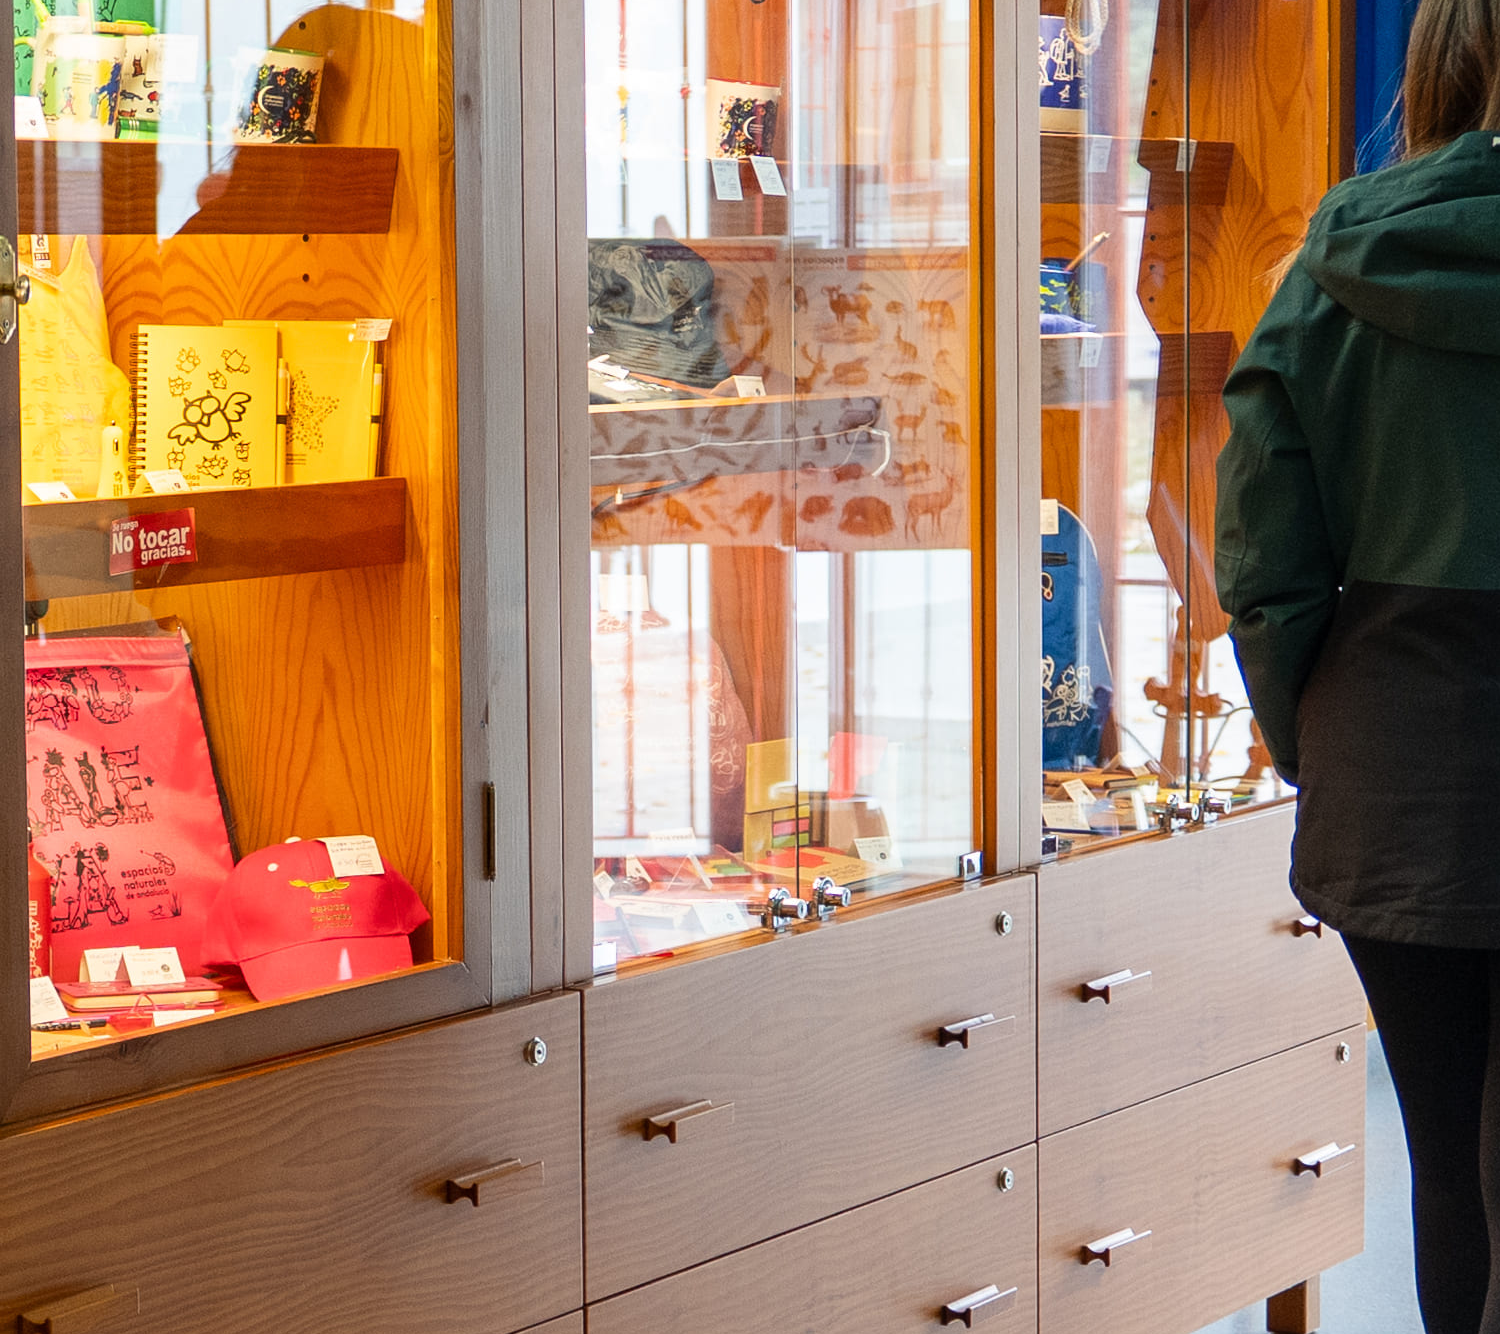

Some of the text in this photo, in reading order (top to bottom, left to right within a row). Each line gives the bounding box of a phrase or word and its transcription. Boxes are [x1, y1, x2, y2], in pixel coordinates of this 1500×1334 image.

[111, 526, 191, 555] No tocar
[141, 543, 192, 565] gracias.
[120, 864, 164, 880] espacios
[124, 876, 167, 891] naturales
